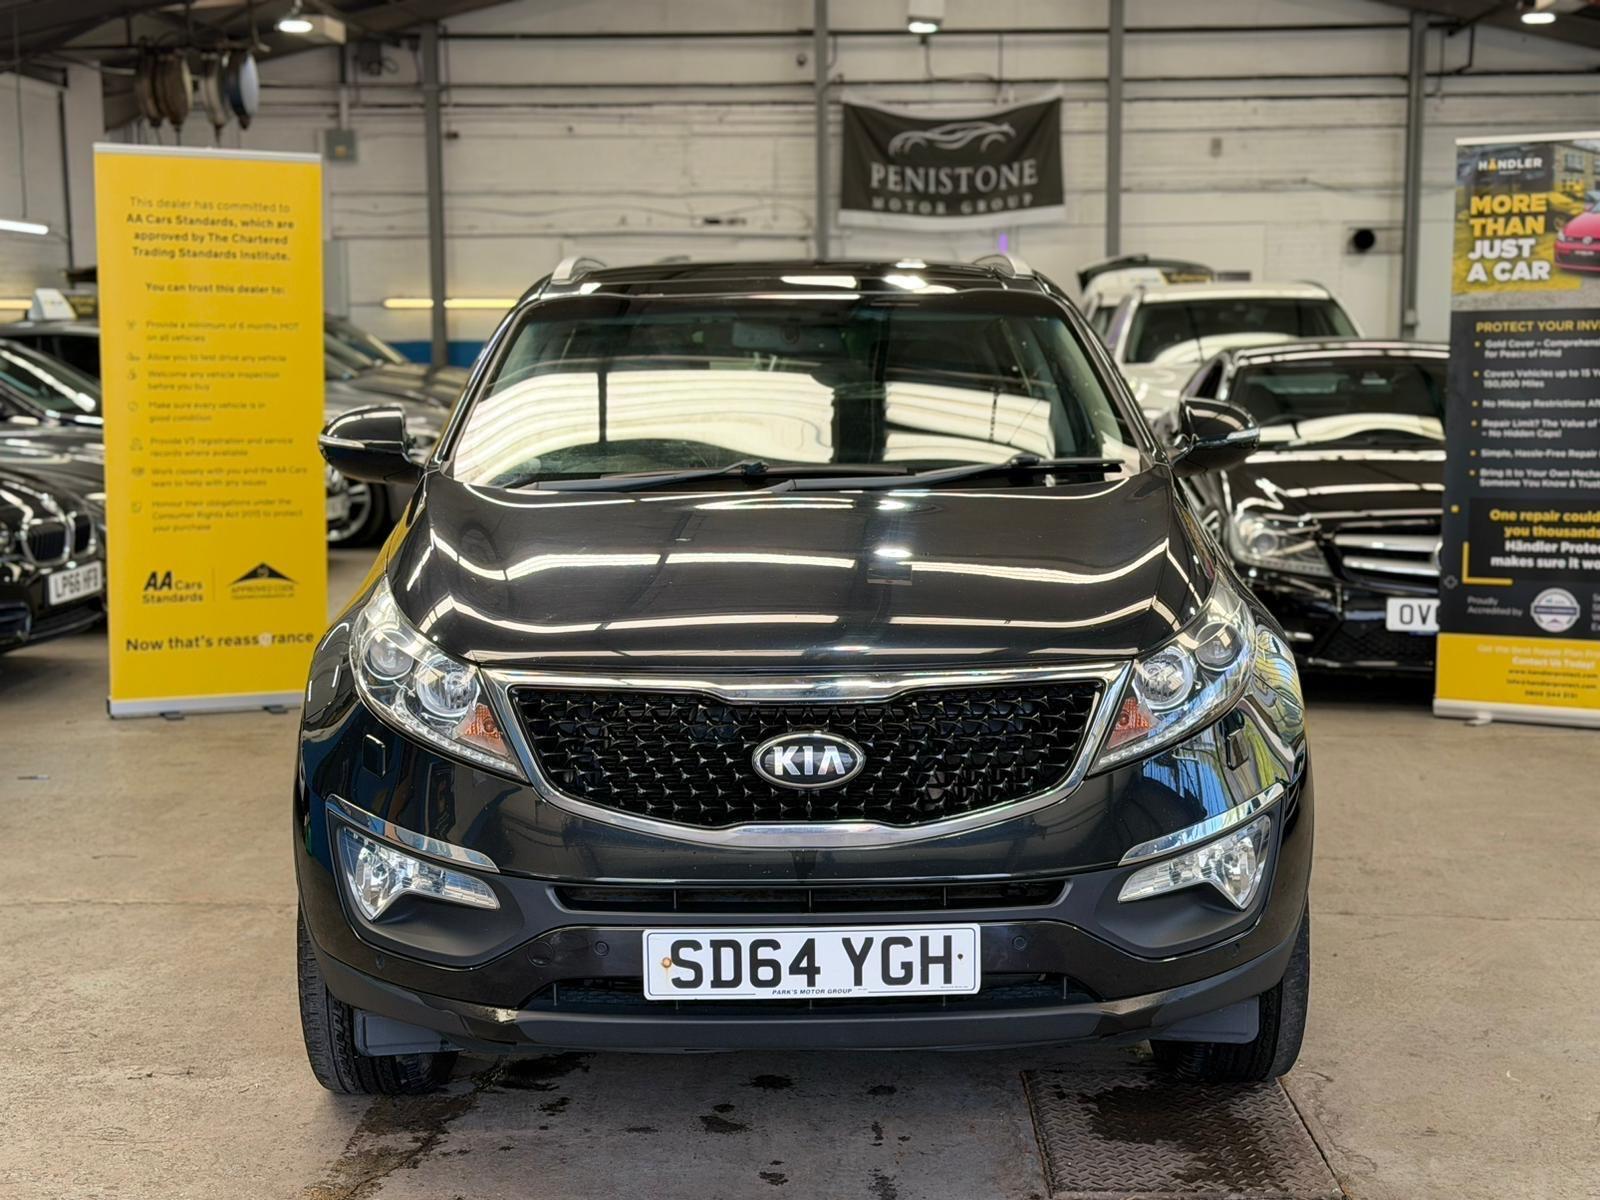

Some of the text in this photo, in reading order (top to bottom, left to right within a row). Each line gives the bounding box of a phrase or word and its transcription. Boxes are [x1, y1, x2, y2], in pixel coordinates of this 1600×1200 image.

[870, 158, 1039, 194] PENISTONE
[130, 196, 290, 213] This dealer has committed to
[871, 193, 1033, 215] MOTOR GROUP
[1470, 193, 1547, 215] MORE
[126, 213, 294, 229] AA Cars Standards, which are
[1469, 215, 1545, 237] THAN
[133, 231, 288, 245] approved by The Chartered
[132, 246, 291, 261] Trading Standards Institute.
[1468, 238, 1536, 260] JUST
[1466, 260, 1551, 282] A CAR
[145, 281, 165, 292] You
[167, 284, 186, 293] can
[188, 283, 213, 293] trust
[215, 283, 235, 294] this
[237, 284, 268, 295] dealer
[1476, 320, 1535, 333] PROTECT
[1537, 320, 1575, 332] YOUR
[1489, 508, 1600, 524] One repair could
[1503, 526, 1531, 540] you
[1490, 554, 1536, 568] makes
[1535, 557, 1568, 569] sure
[143, 570, 204, 591] AA Cars
[142, 592, 204, 604] Standards
[126, 638, 164, 651] Now
[168, 635, 214, 649] that's
[773, 745, 846, 776] KIA
[670, 934, 953, 989] SD64 YGH
